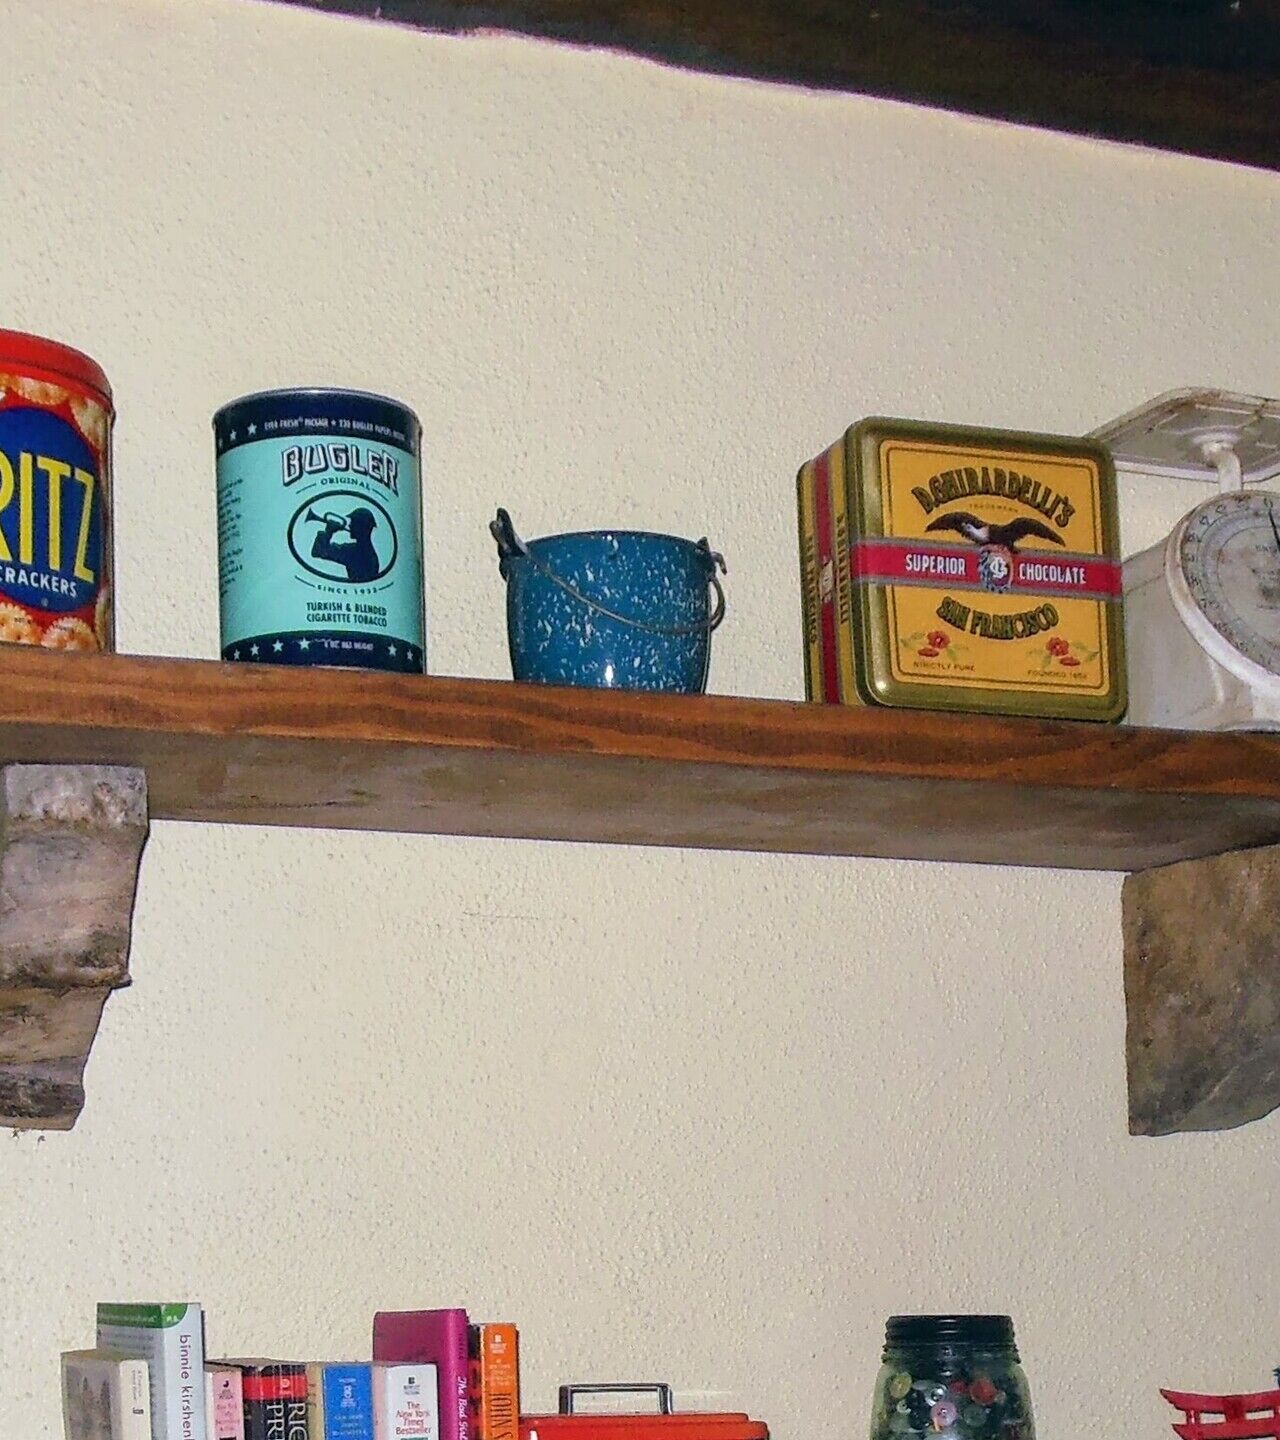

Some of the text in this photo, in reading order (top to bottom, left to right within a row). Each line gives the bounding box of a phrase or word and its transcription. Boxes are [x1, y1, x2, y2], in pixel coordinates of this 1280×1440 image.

[282, 443, 398, 497] BUGLER
[321, 477, 370, 490] ORIGINAL
[905, 554, 966, 576] SUPERIOR
[1020, 563, 1086, 584] CHOCOLATE
[318, 585, 347, 594] SINCE
[307, 602, 387, 616] TURKISH & BLENDED
[936, 596, 1059, 640] SAN FRANCISCO
[307, 614, 387, 627] CIGARETTE TOBACCO
[179, 1334, 192, 1380] binnie
[458, 1376, 467, 1395] The
[396, 1410, 412, 1418] New
[459, 1398, 468, 1419] Bad
[489, 1392, 513, 1429] JOHN
[395, 1427, 432, 1435] Bestseller
